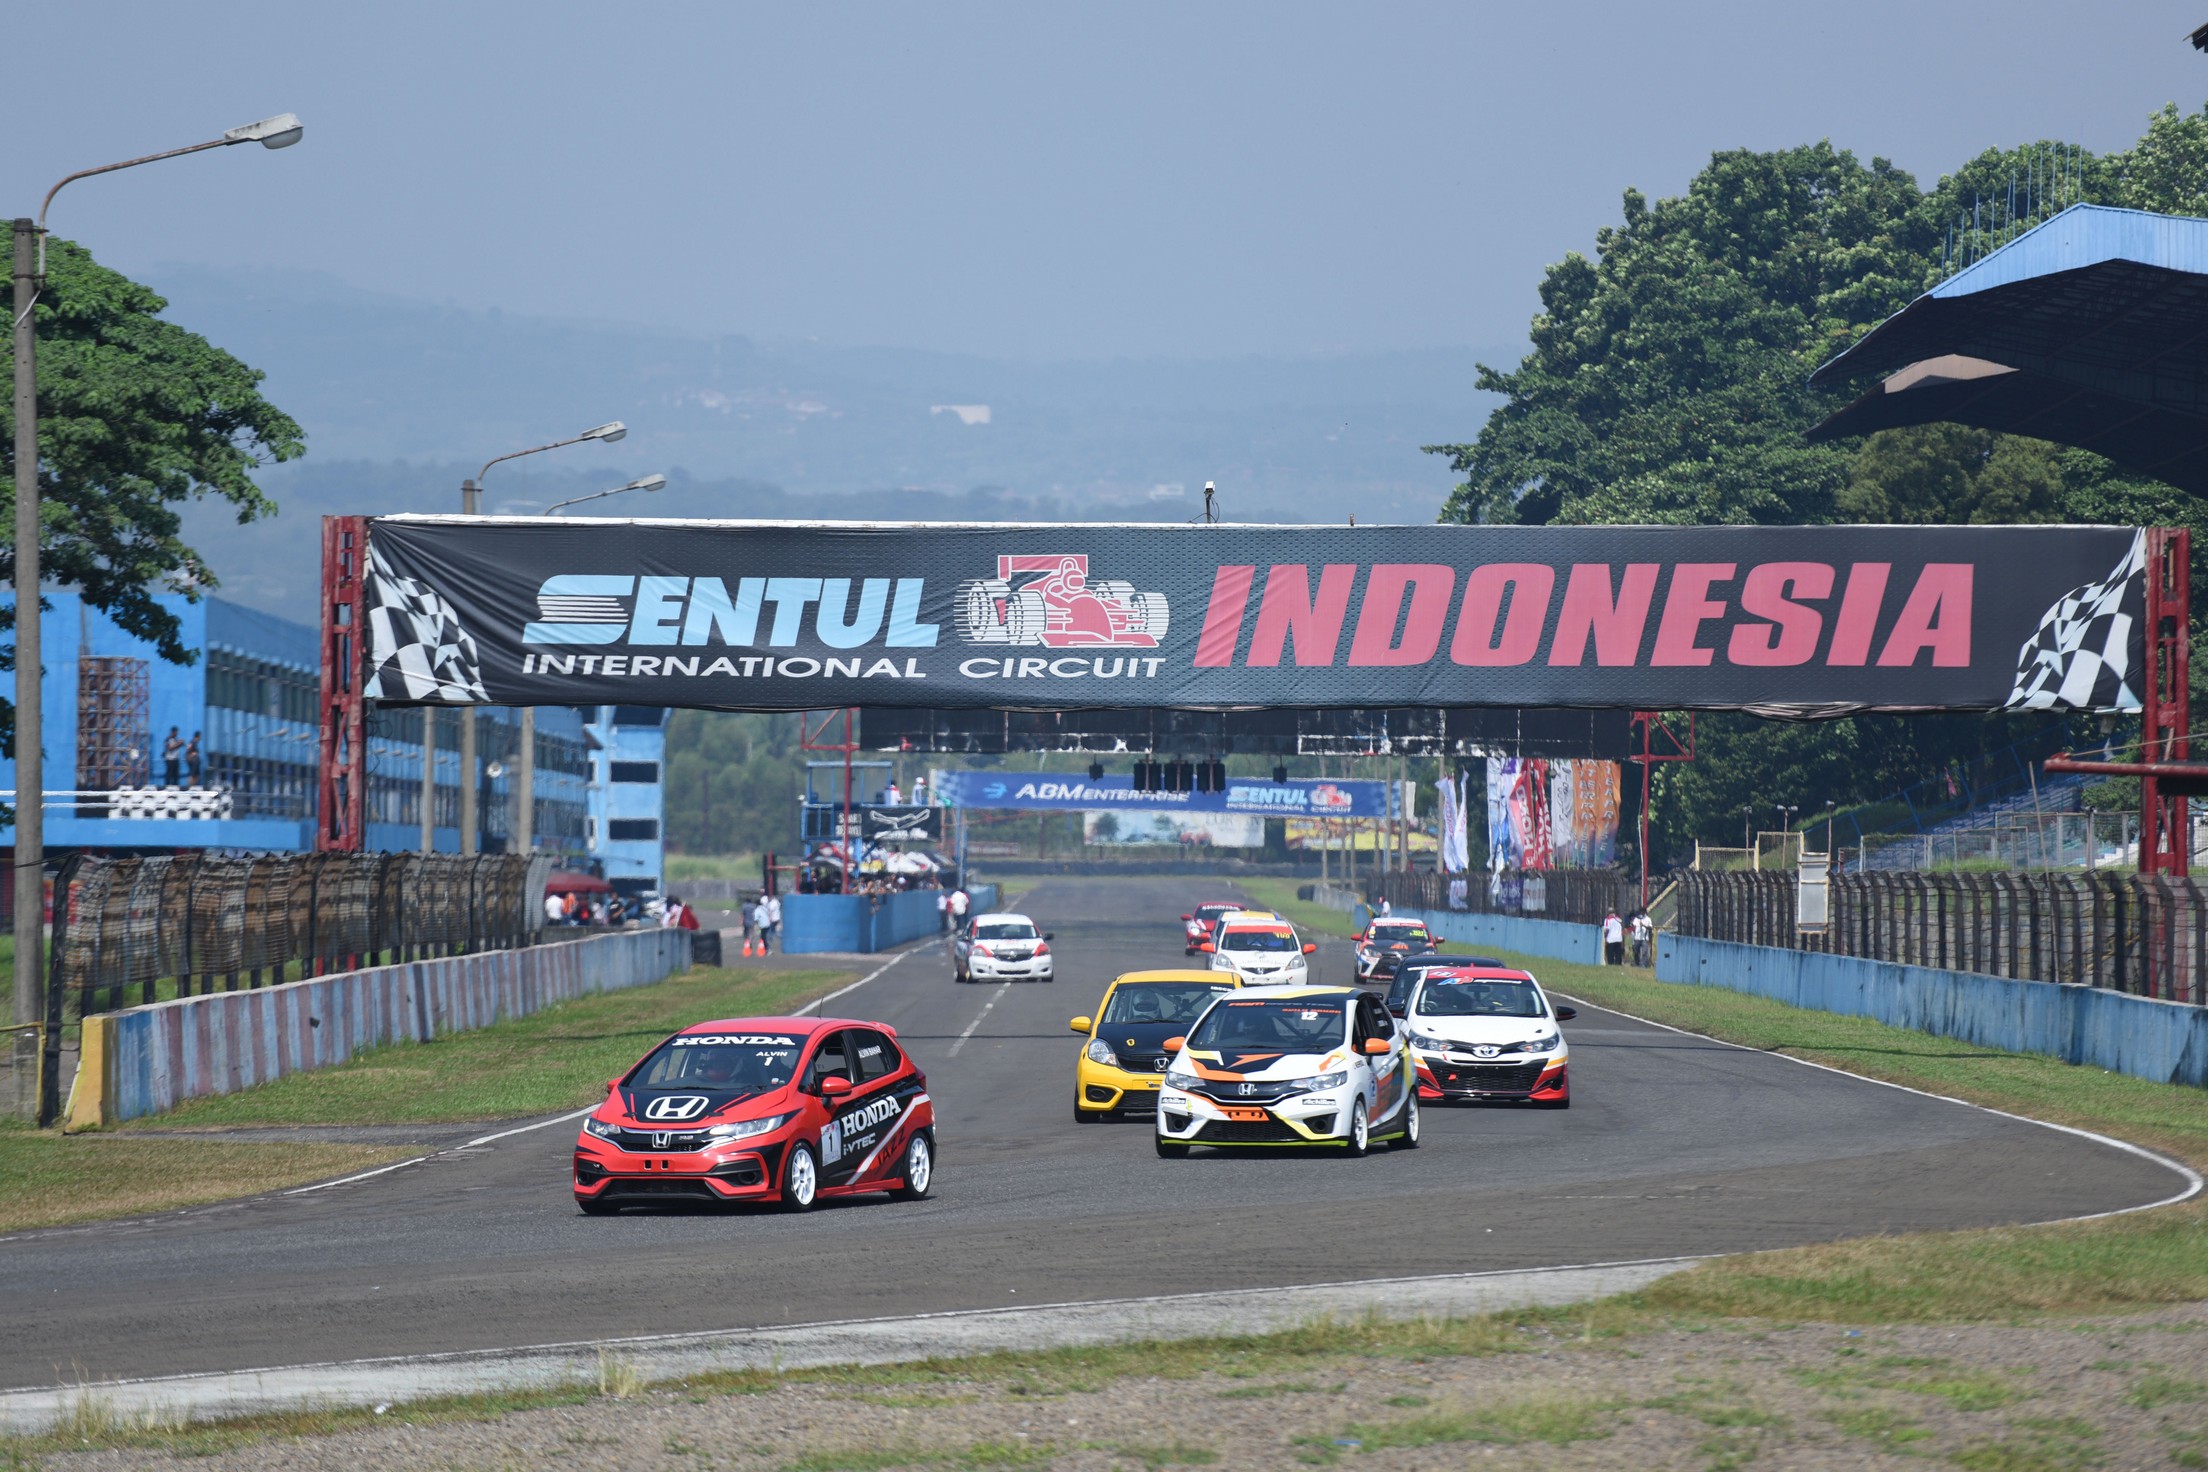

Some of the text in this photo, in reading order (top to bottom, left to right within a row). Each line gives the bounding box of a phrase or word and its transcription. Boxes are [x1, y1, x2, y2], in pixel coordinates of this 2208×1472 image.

[522, 574, 940, 649] SENTUL
[1193, 562, 1975, 668] INDONESIA
[522, 652, 1166, 681] INTERNATIONAL CIRCUIT
[1227, 786, 1308, 805] SENTUL
[1301, 1012, 1319, 1020] 12
[672, 1036, 796, 1046] HONDA
[764, 1057, 774, 1067] 1
[841, 1095, 901, 1138] HONDA
[829, 1133, 833, 1153] 1
[843, 1132, 876, 1156] i-VTEC
[877, 1126, 906, 1166] JAZZ
